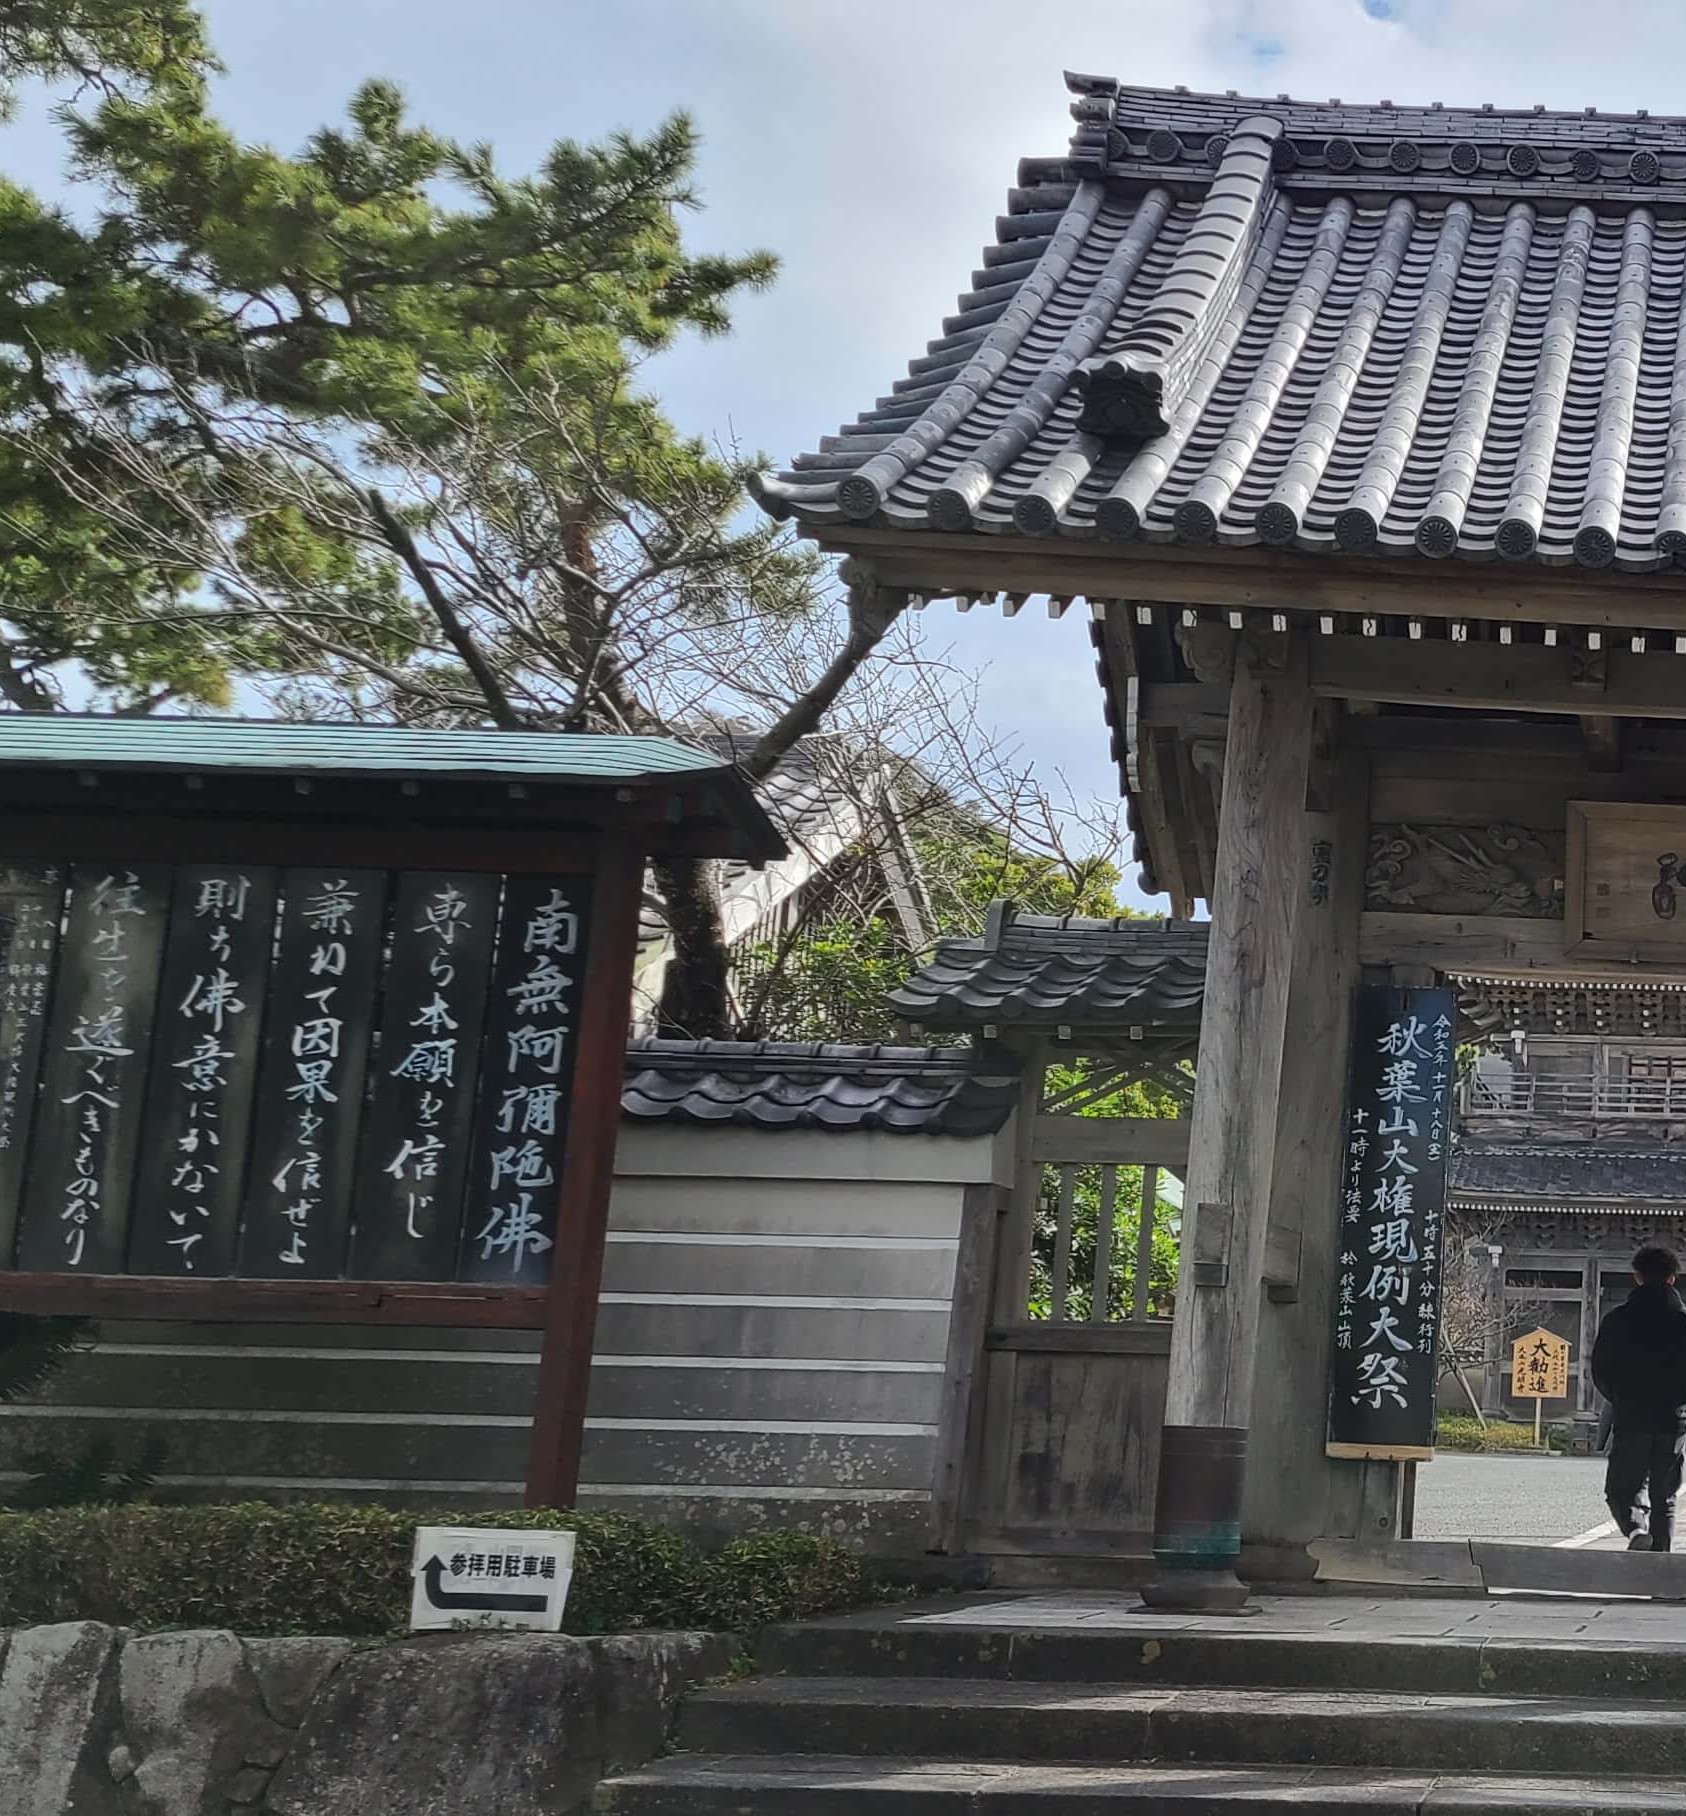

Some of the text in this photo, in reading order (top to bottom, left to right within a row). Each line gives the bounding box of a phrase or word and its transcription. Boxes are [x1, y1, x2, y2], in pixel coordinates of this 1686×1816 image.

[1350, 1015, 1434, 1409] 秋葉山大権現例大祭
[450, 1552, 556, 1579] 参拝用駐車場
